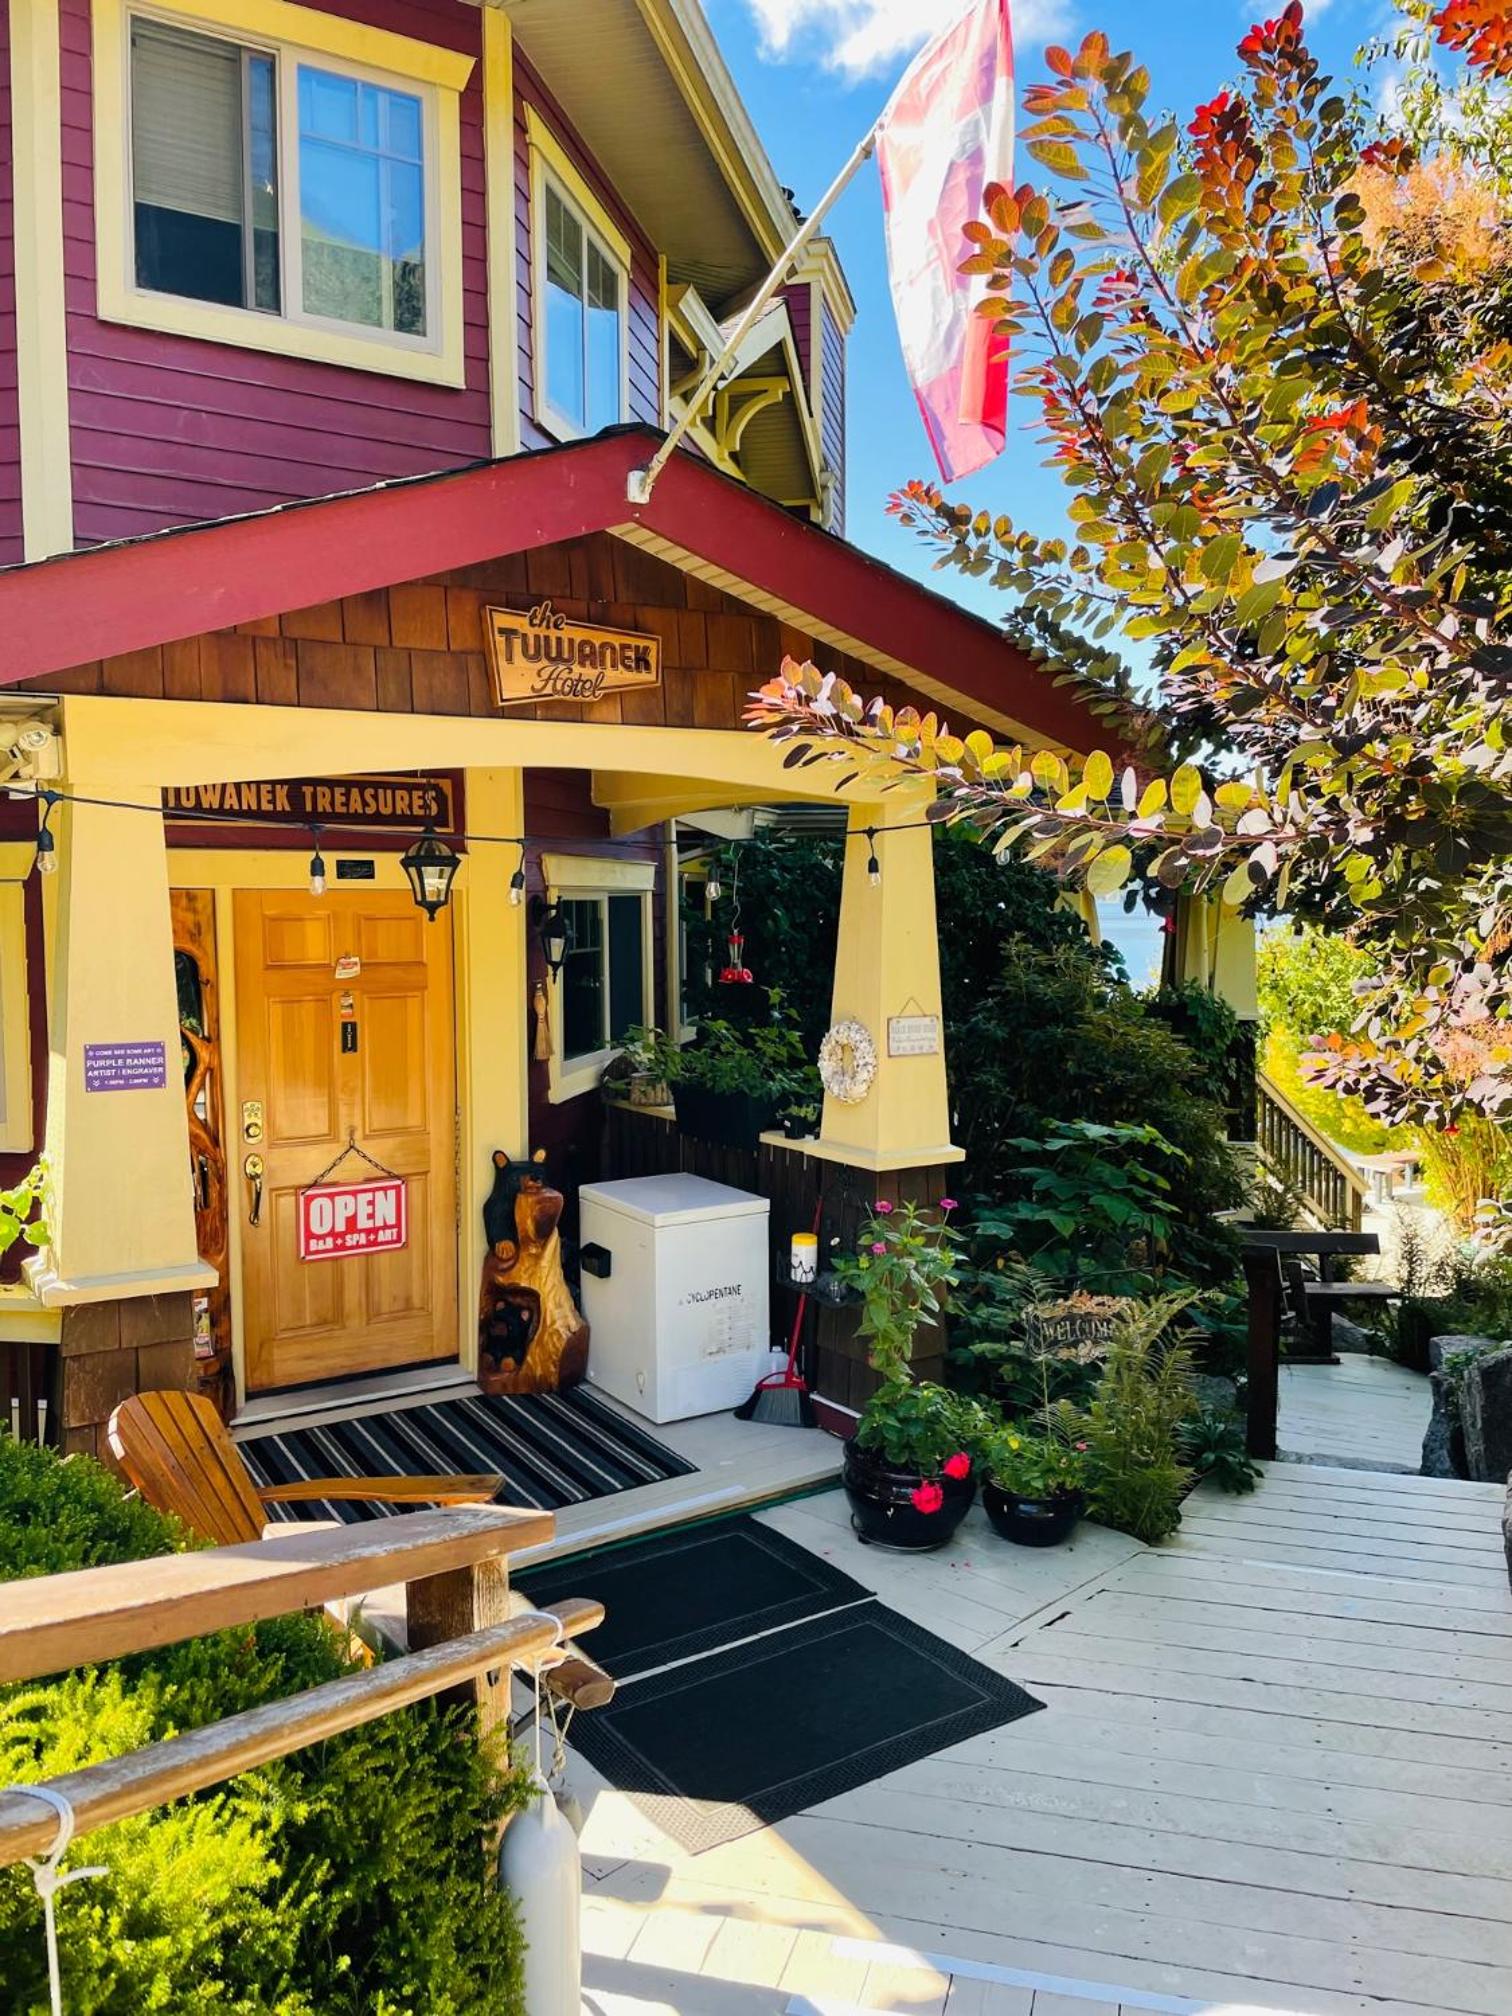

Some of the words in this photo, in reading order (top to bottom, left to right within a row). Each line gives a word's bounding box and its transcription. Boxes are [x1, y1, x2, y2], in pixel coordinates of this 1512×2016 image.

[528, 601, 566, 630] the
[497, 627, 652, 673] TUWANEK
[531, 665, 606, 698] Hotel
[166, 783, 291, 811] TUWANEK
[302, 786, 438, 817] TREASURES
[86, 1059, 125, 1067] PURPLE
[87, 1069, 116, 1077] ARTIST
[122, 1067, 163, 1076] ENGRAVER
[309, 1189, 397, 1235] OPEN
[345, 1232, 367, 1246] SPA
[377, 1228, 398, 1242] ART
[1042, 1319, 1115, 1340] WELCOM
